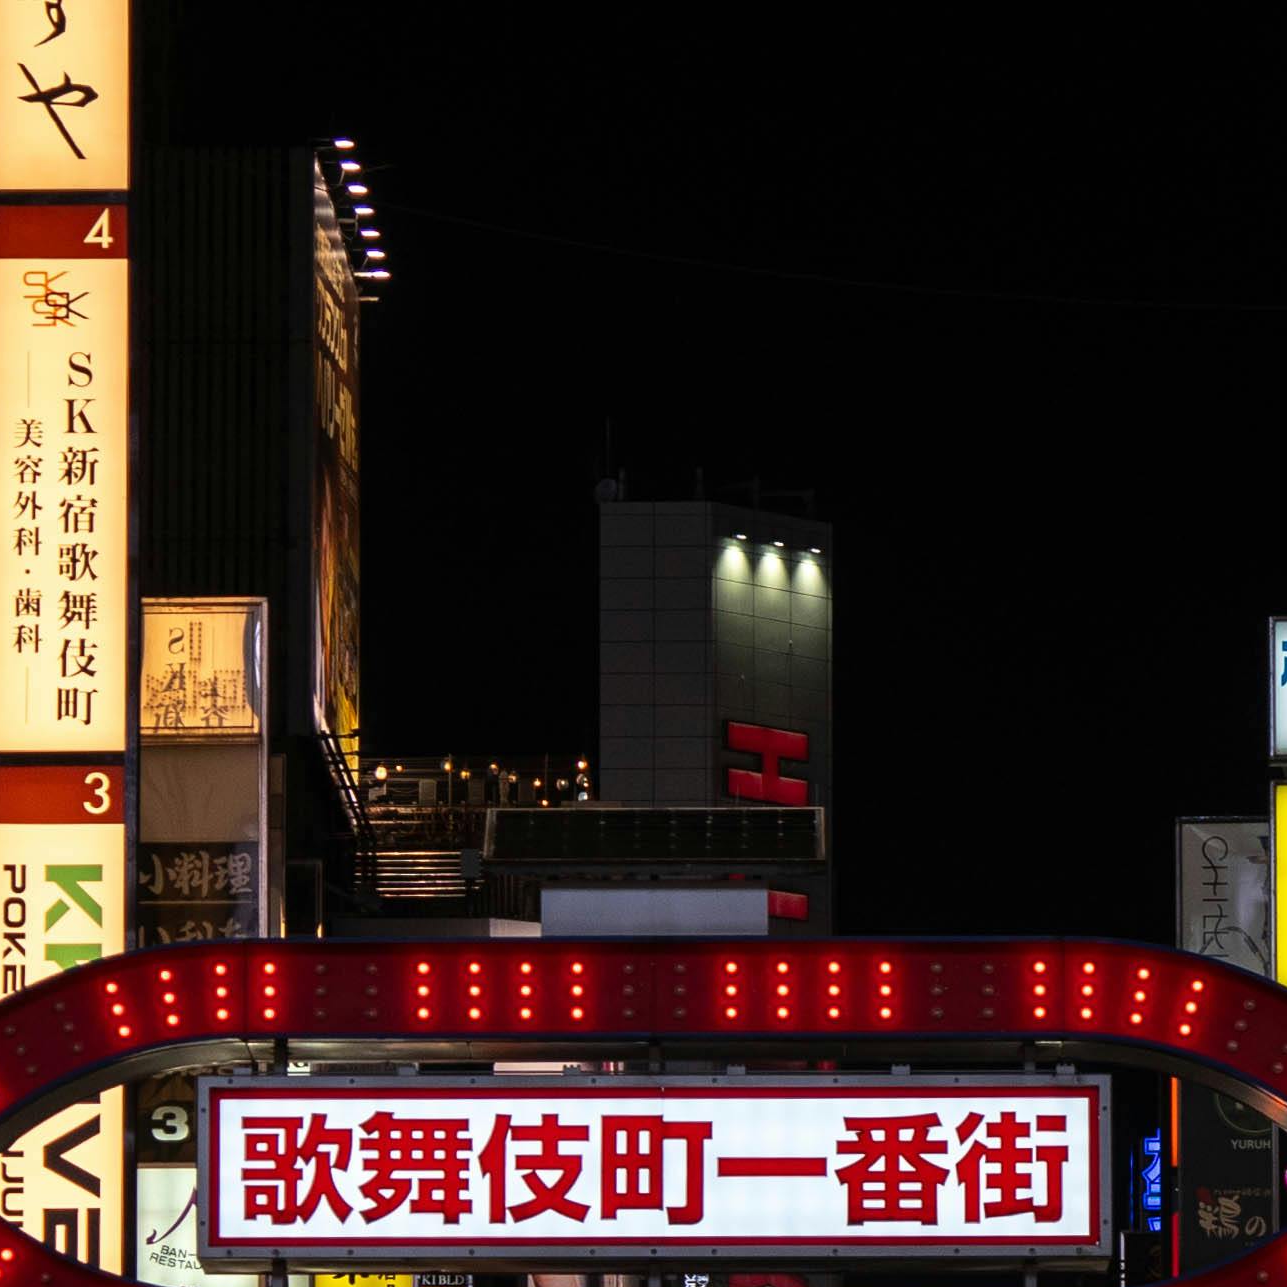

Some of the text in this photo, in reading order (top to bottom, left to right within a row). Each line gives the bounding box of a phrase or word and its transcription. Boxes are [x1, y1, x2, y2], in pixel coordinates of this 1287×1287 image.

[84, 208, 114, 249] 4
[13, 419, 44, 655] 美容外科・歯科
[57, 352, 100, 727] SK新宿歌舞伎町
[83, 773, 112, 815] 3
[138, 851, 253, 897] 小料理
[2, 864, 27, 994] POKE
[151, 1106, 190, 1142] 3
[241, 1109, 1068, 1226] 歌舞伎町一番街
